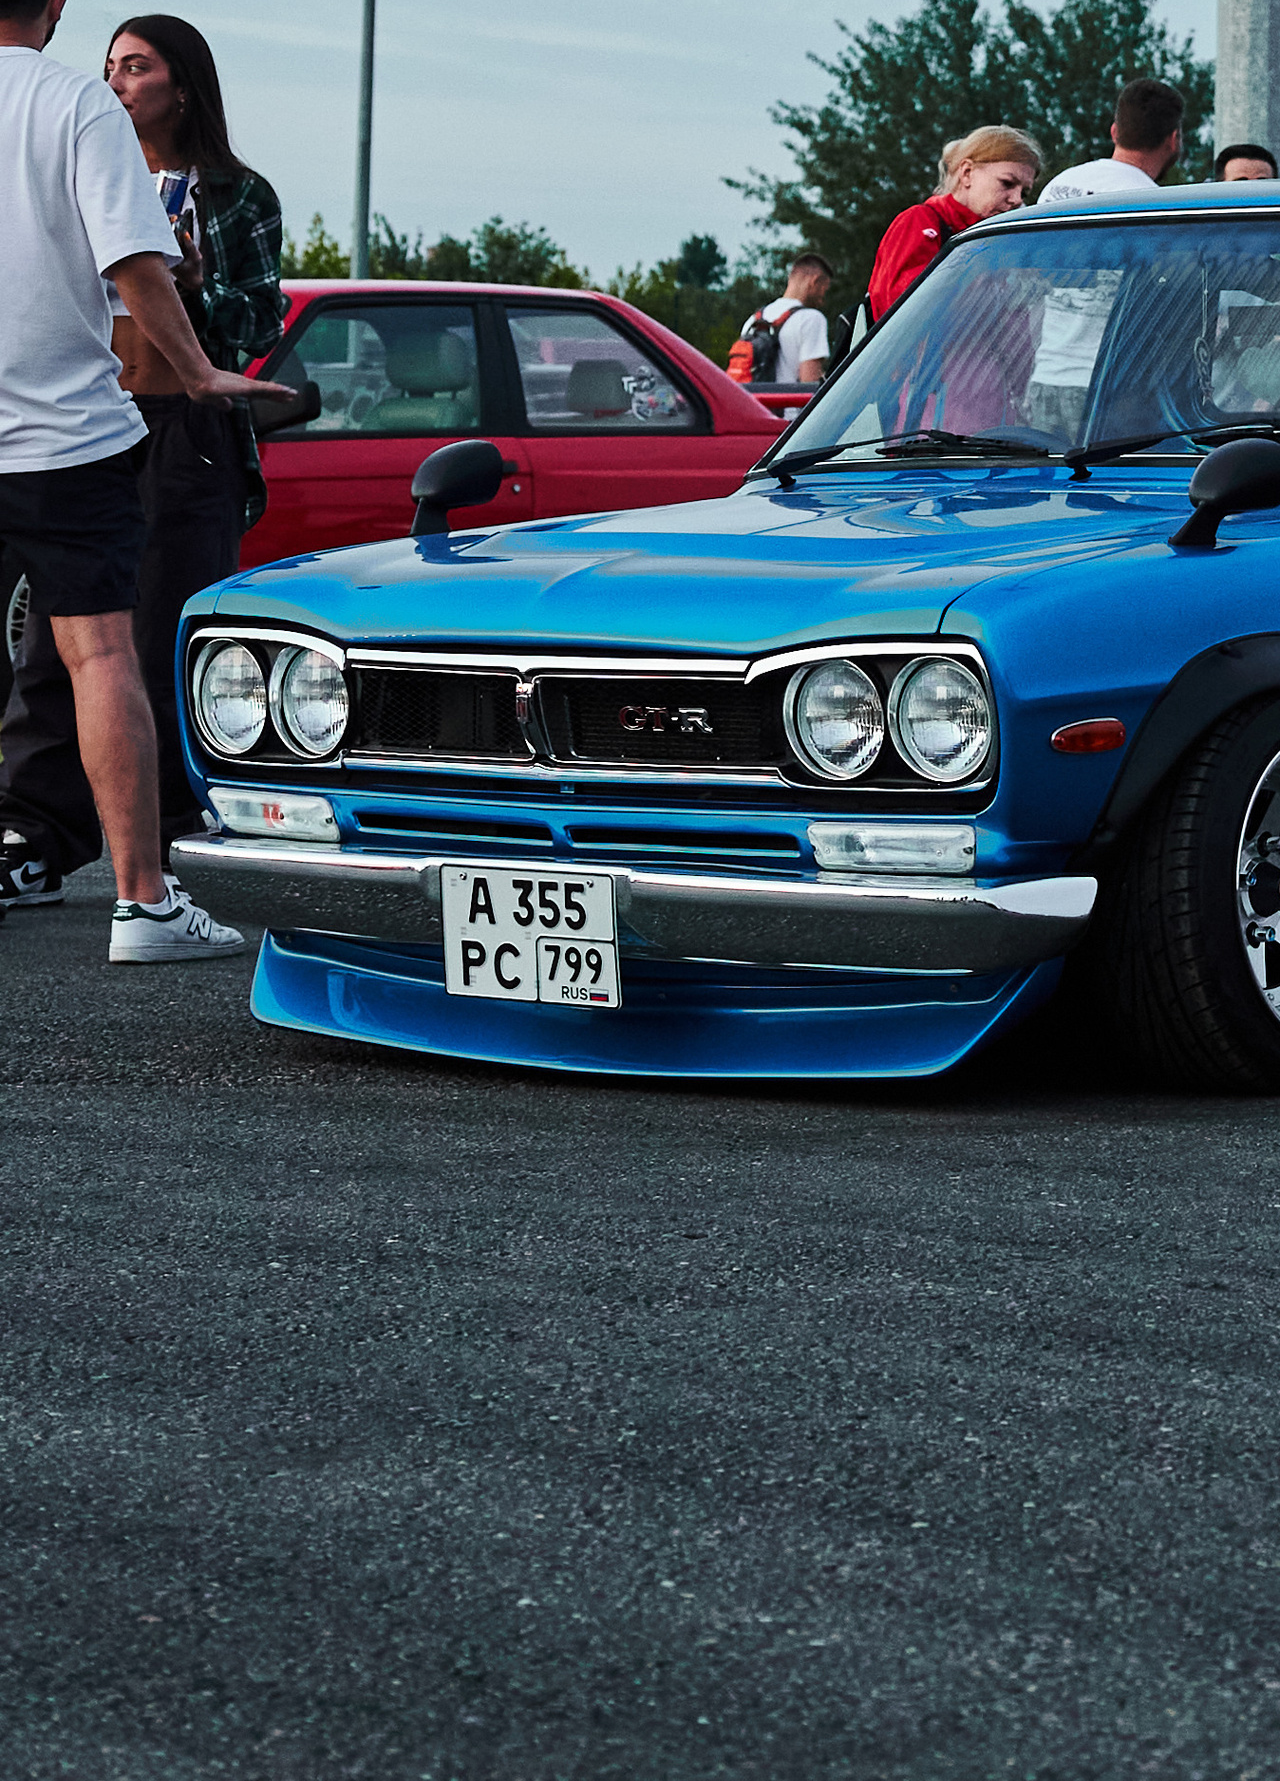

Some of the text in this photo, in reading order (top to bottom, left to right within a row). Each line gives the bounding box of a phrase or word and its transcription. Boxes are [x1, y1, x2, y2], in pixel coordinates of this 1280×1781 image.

[618, 705, 713, 733] GT-R
[512, 879, 586, 930] 355
[186, 911, 212, 940] N
[545, 945, 602, 984] 799
[562, 986, 588, 1000] RUS
